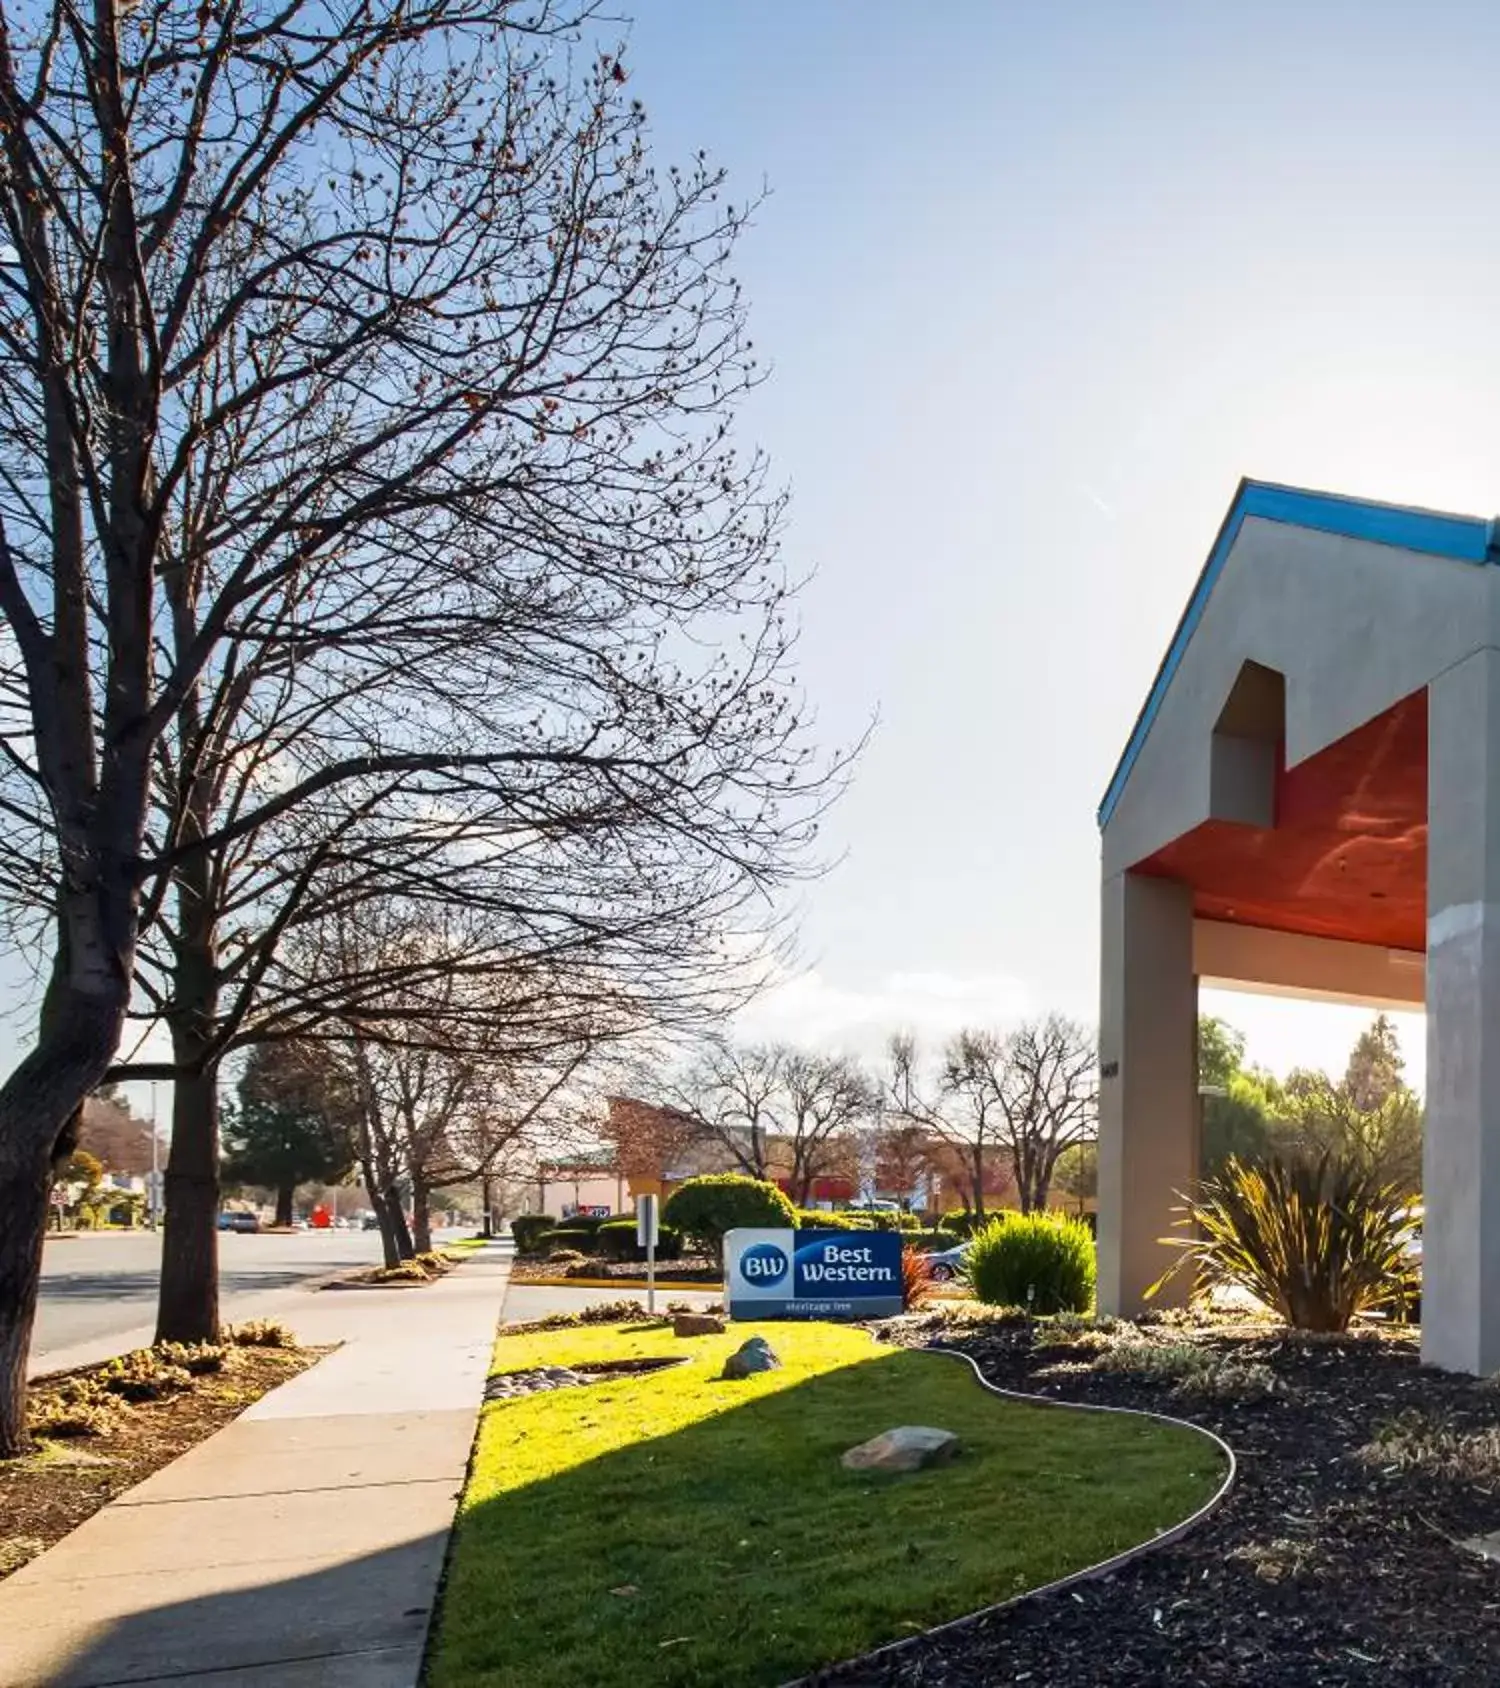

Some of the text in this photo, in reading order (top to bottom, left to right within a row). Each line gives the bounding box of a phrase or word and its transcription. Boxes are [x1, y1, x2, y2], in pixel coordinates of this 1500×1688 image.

[823, 1245, 873, 1264] Best
[745, 1256, 785, 1277] BW
[801, 1263, 892, 1282] Western
